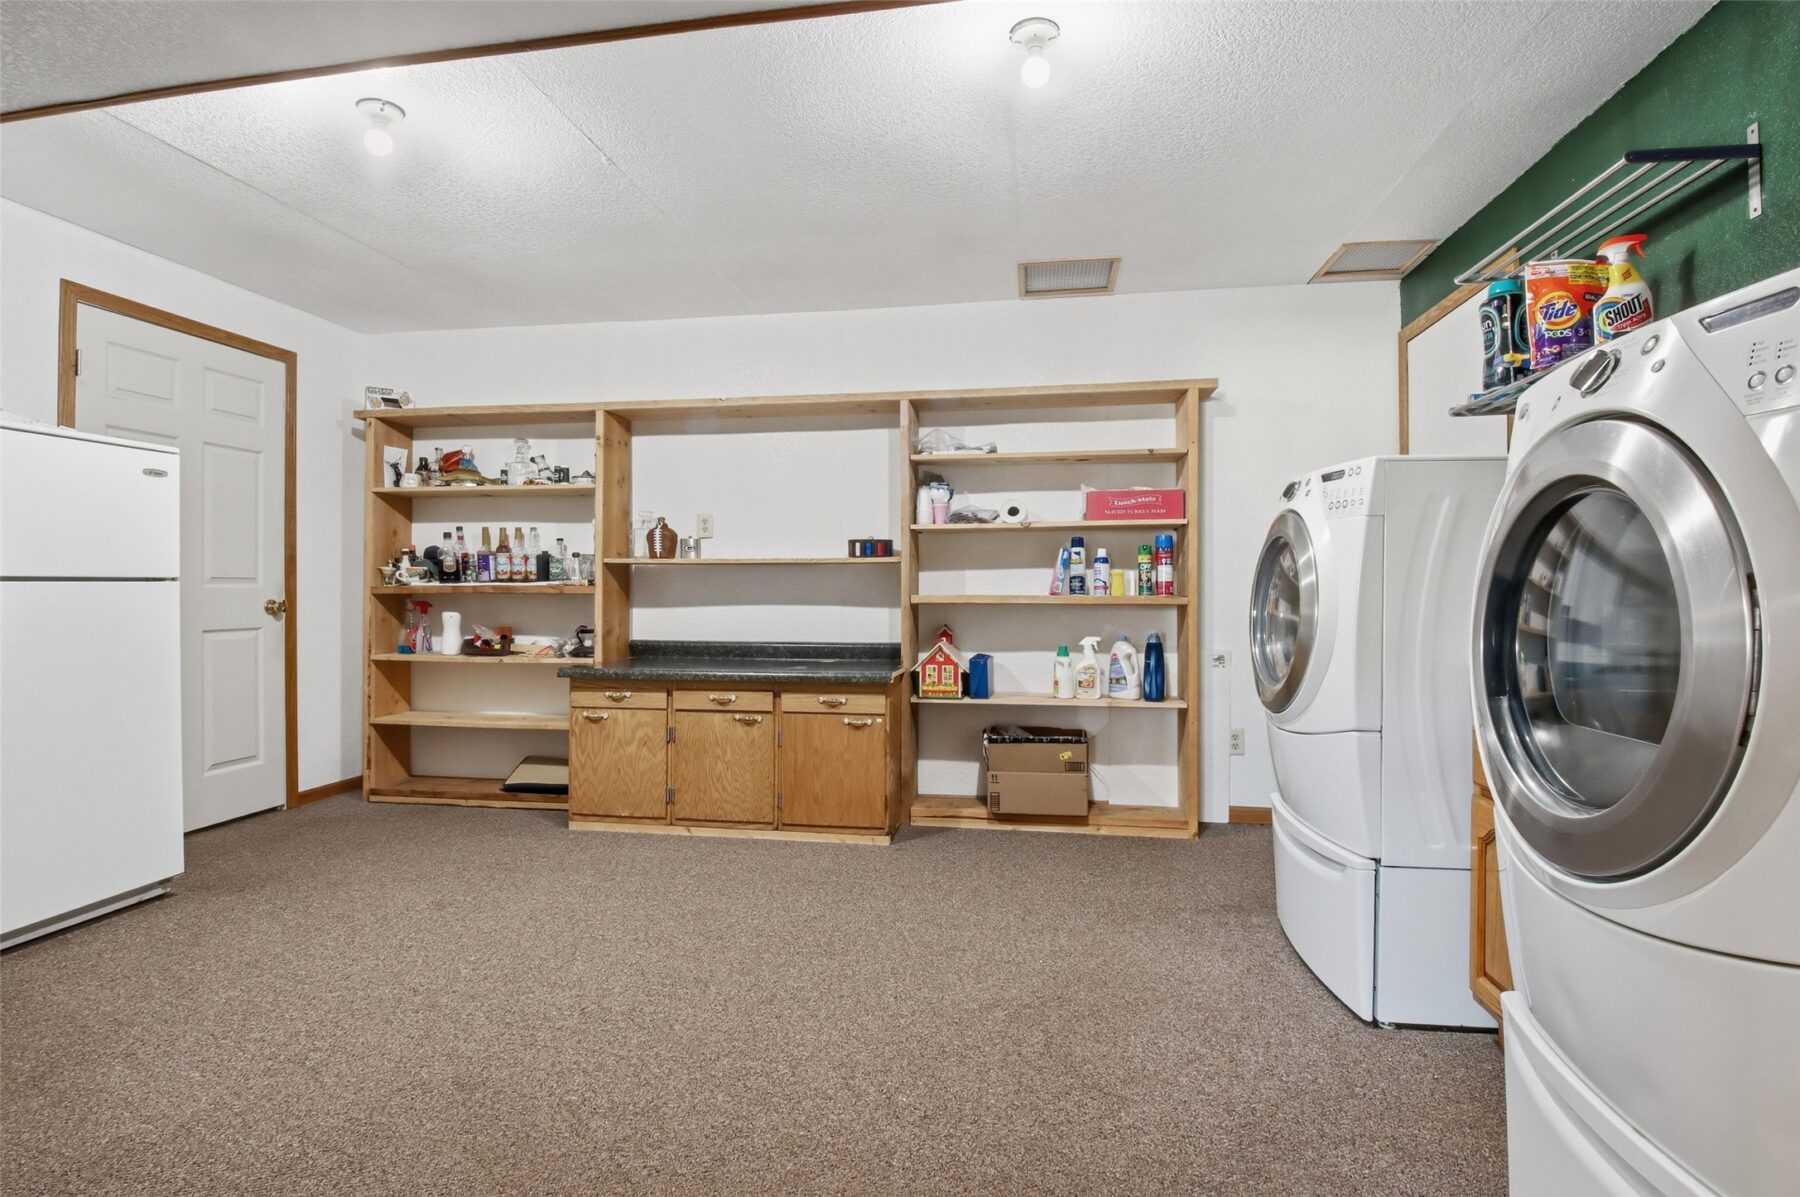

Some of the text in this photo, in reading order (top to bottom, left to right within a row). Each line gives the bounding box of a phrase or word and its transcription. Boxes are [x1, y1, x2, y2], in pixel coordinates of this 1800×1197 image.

[1539, 300, 1578, 322] Tide
[1604, 293, 1643, 327] SHOUT
[1544, 328, 1573, 338] PODS
[1114, 498, 1137, 506] Lunch
